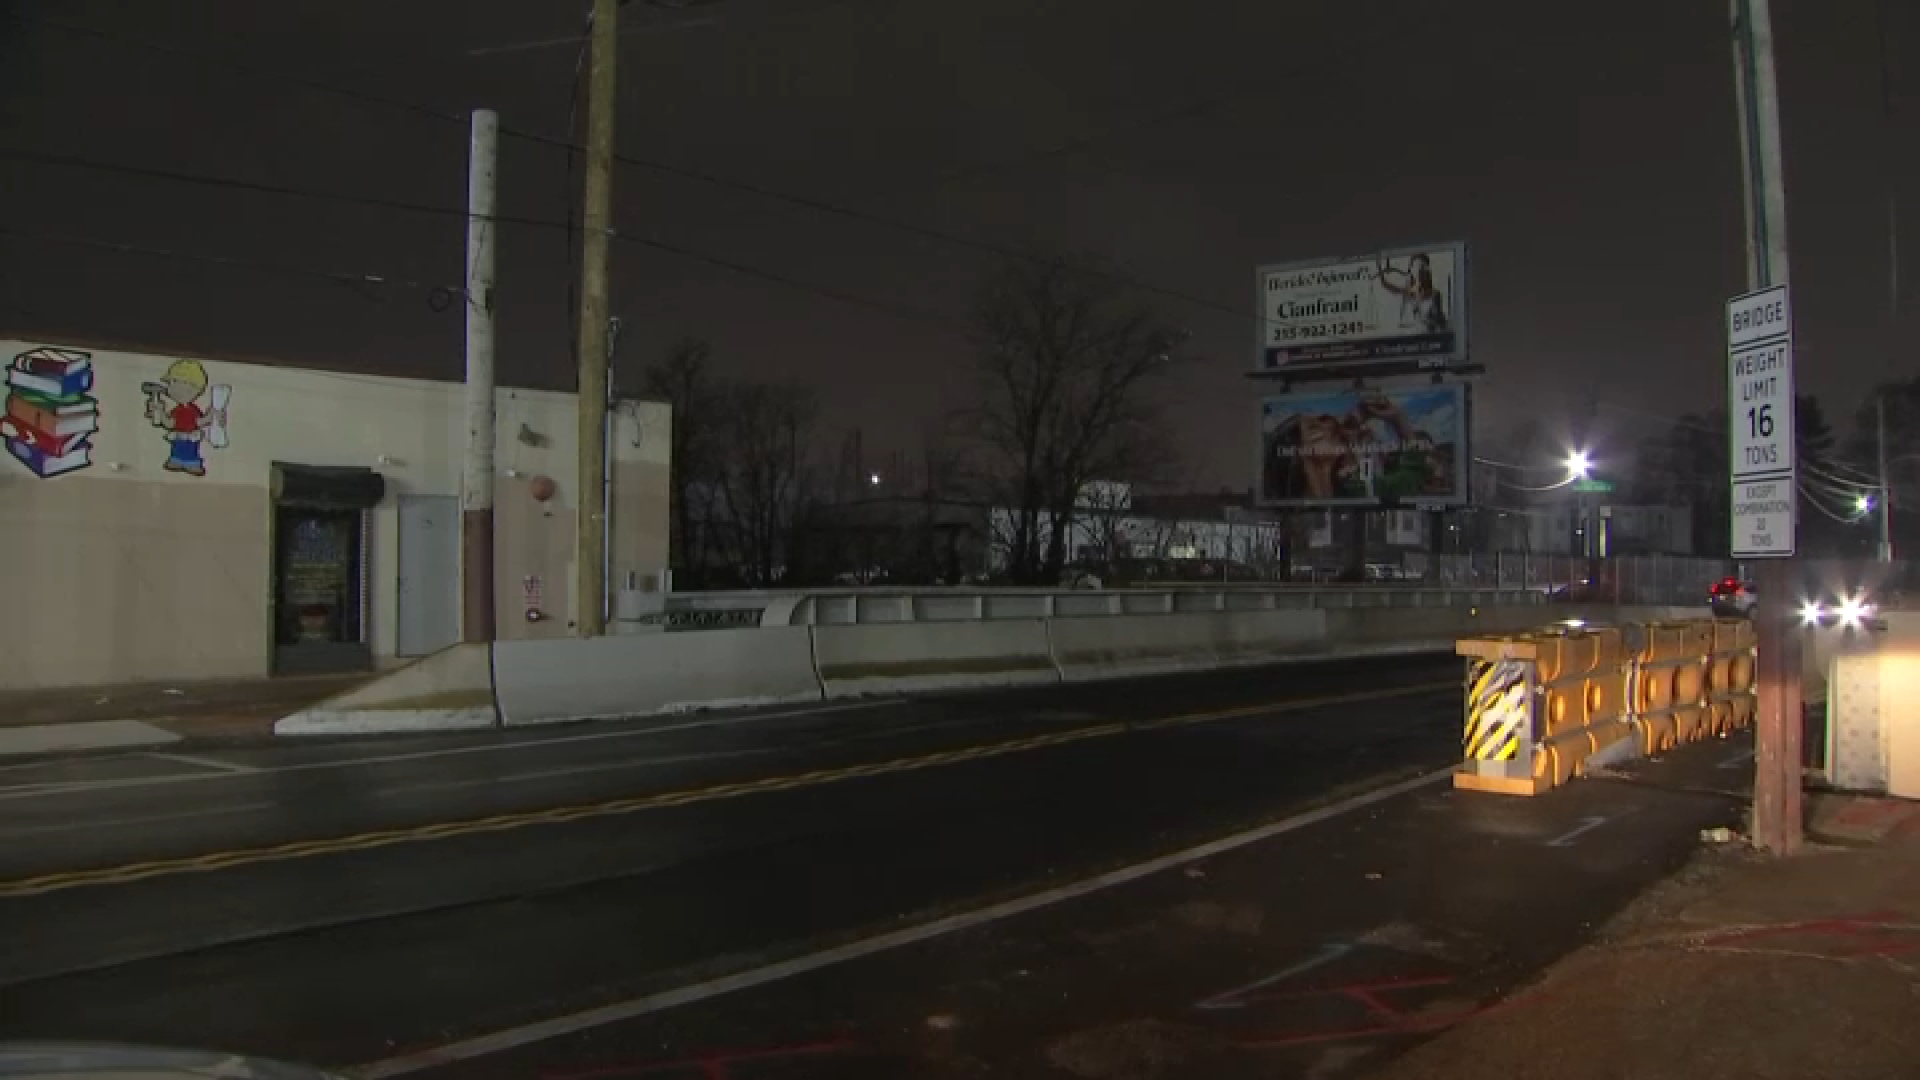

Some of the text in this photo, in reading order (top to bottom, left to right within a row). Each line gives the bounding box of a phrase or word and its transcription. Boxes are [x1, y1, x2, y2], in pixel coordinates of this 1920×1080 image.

[1277, 293, 1358, 318] Cianfrani
[1733, 301, 1782, 332] BRIDGE
[1736, 347, 1784, 376] WEIGHT
[1744, 377, 1777, 401] LIMIT
[1748, 403, 1774, 438] 16
[1744, 443, 1777, 465] TONS
